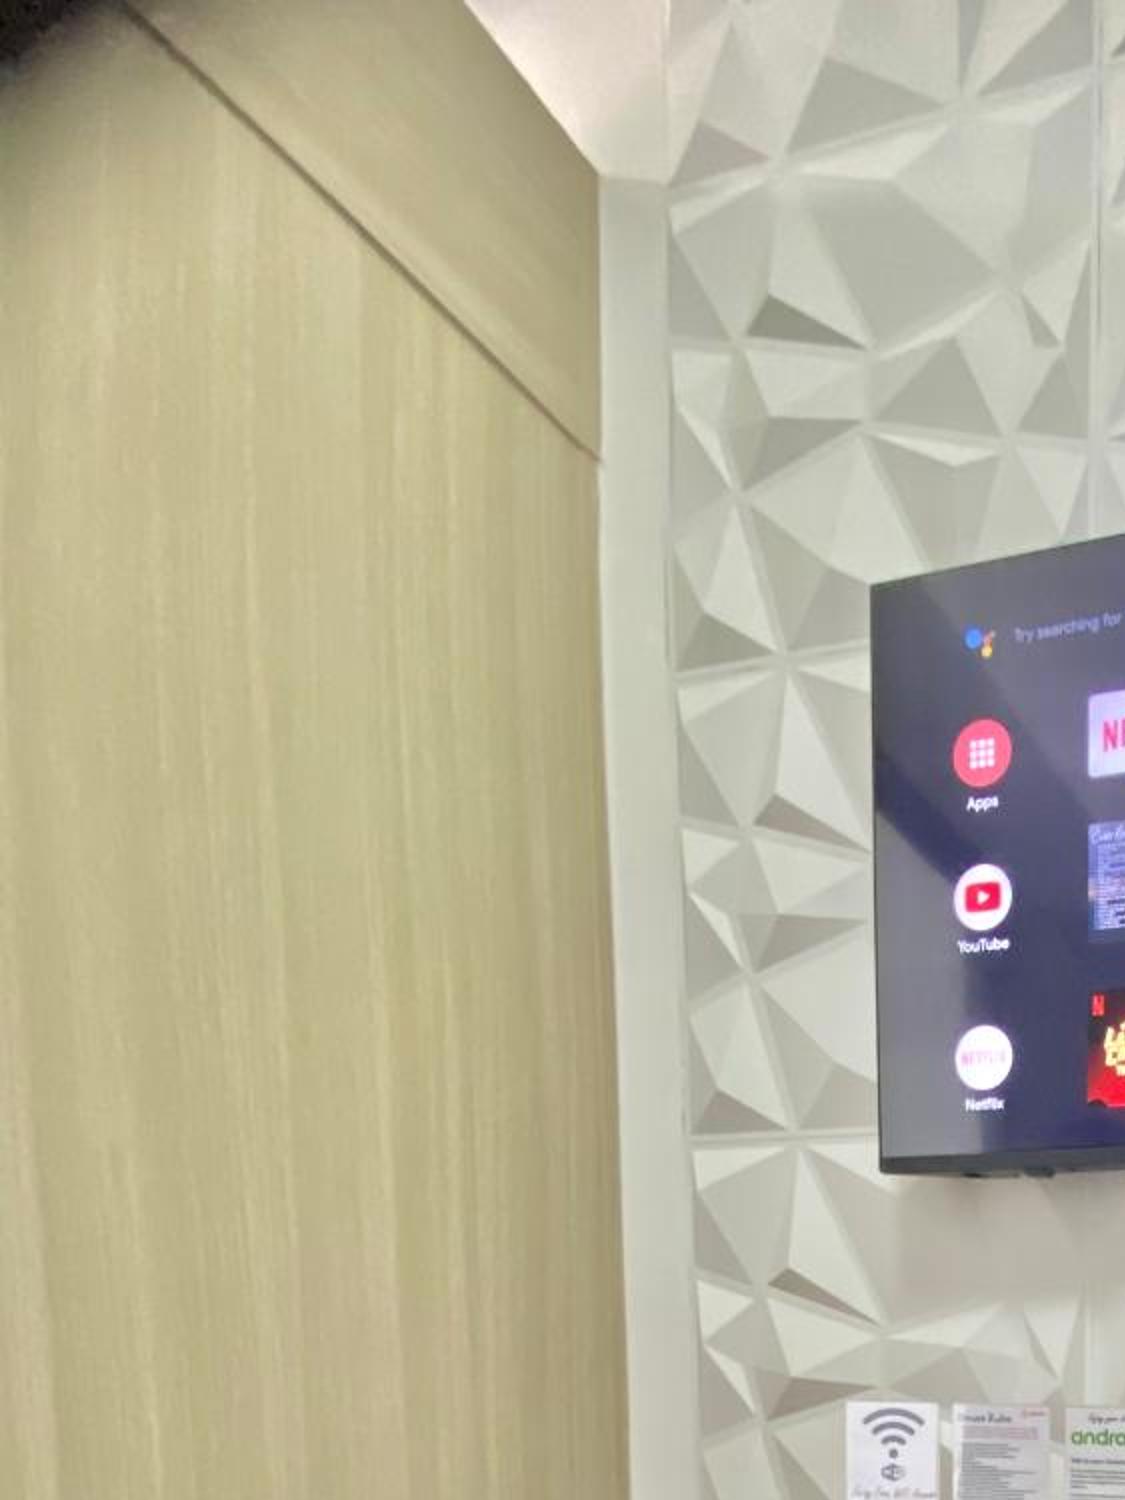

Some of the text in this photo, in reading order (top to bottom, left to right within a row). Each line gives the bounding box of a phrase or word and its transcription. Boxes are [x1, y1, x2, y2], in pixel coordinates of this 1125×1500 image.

[1014, 626, 1036, 643] Try
[1037, 615, 1099, 641] searching
[1103, 611, 1122, 627] for
[966, 796, 999, 813] Apps
[957, 937, 1010, 953] YouTube
[964, 1096, 1006, 1112] Netflix
